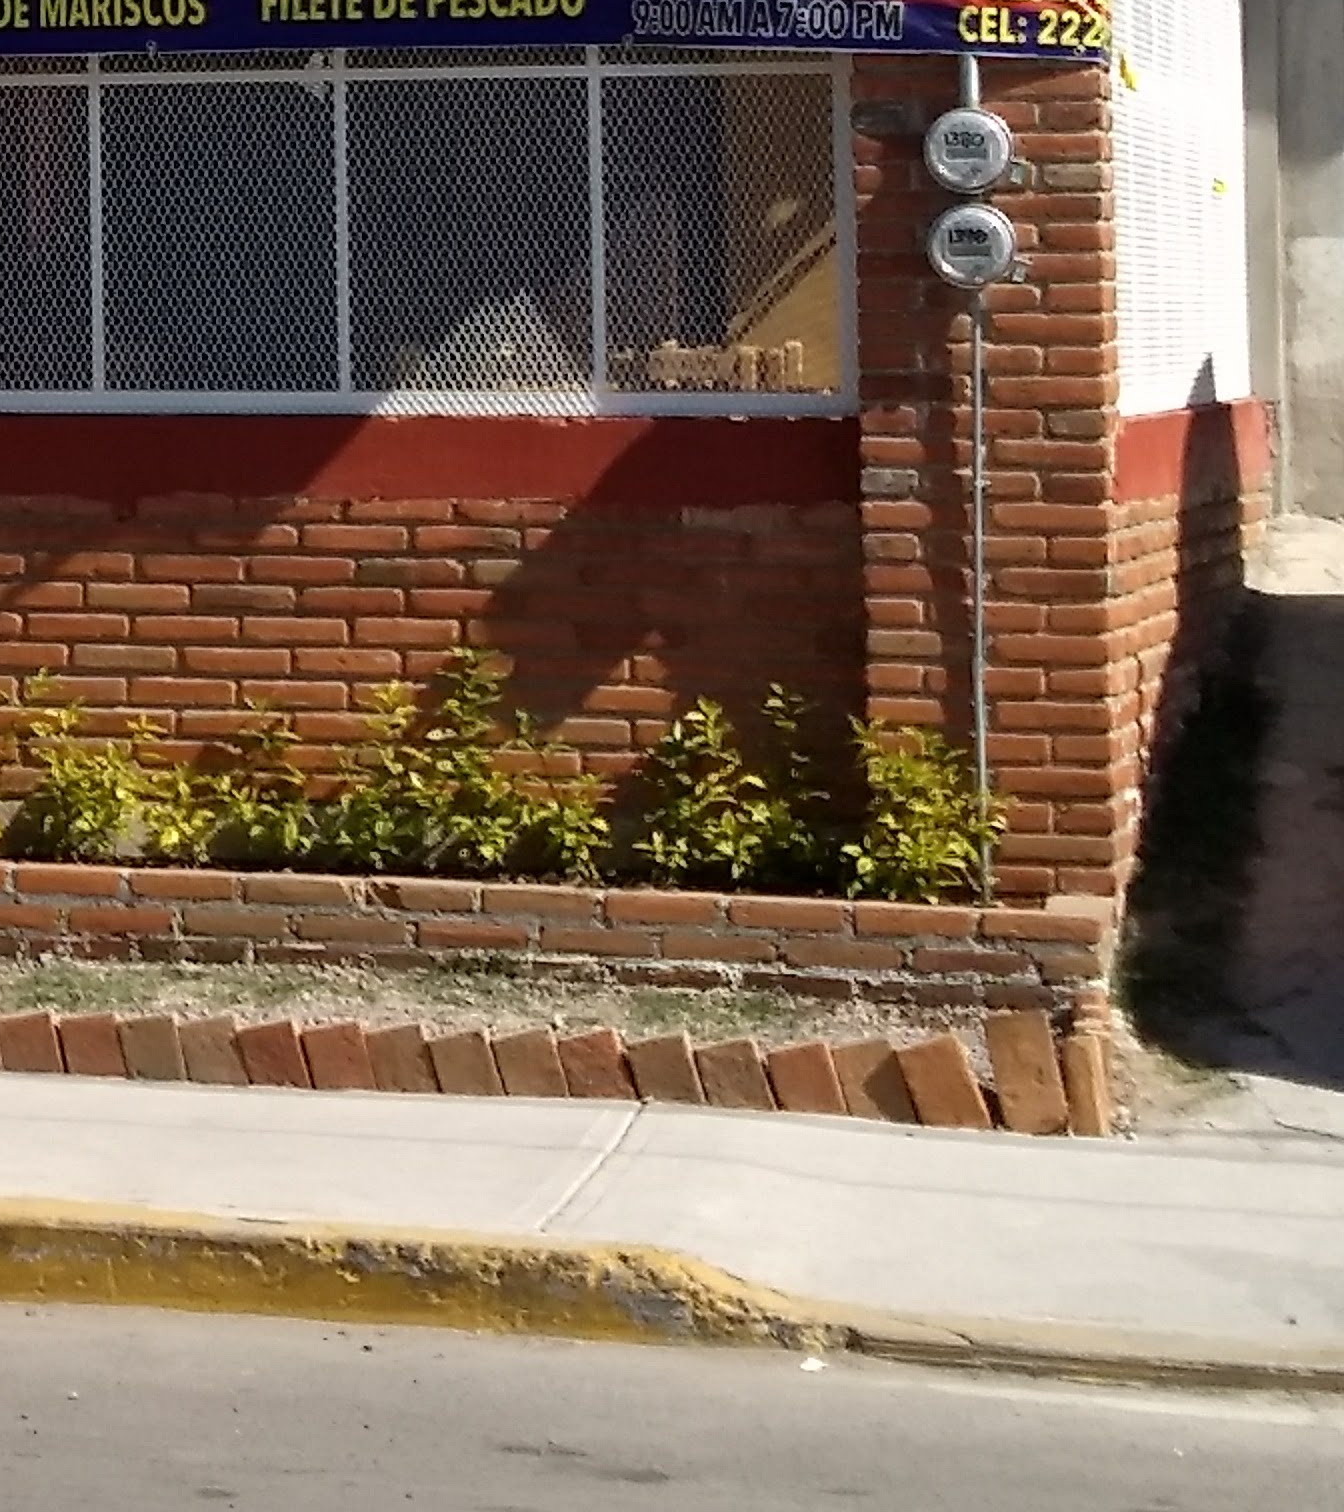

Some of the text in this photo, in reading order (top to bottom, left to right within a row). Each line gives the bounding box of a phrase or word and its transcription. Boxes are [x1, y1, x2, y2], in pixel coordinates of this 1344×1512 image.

[749, 0, 775, 38] A
[852, 0, 904, 42] PM
[958, 6, 1107, 47] CEL: 222
